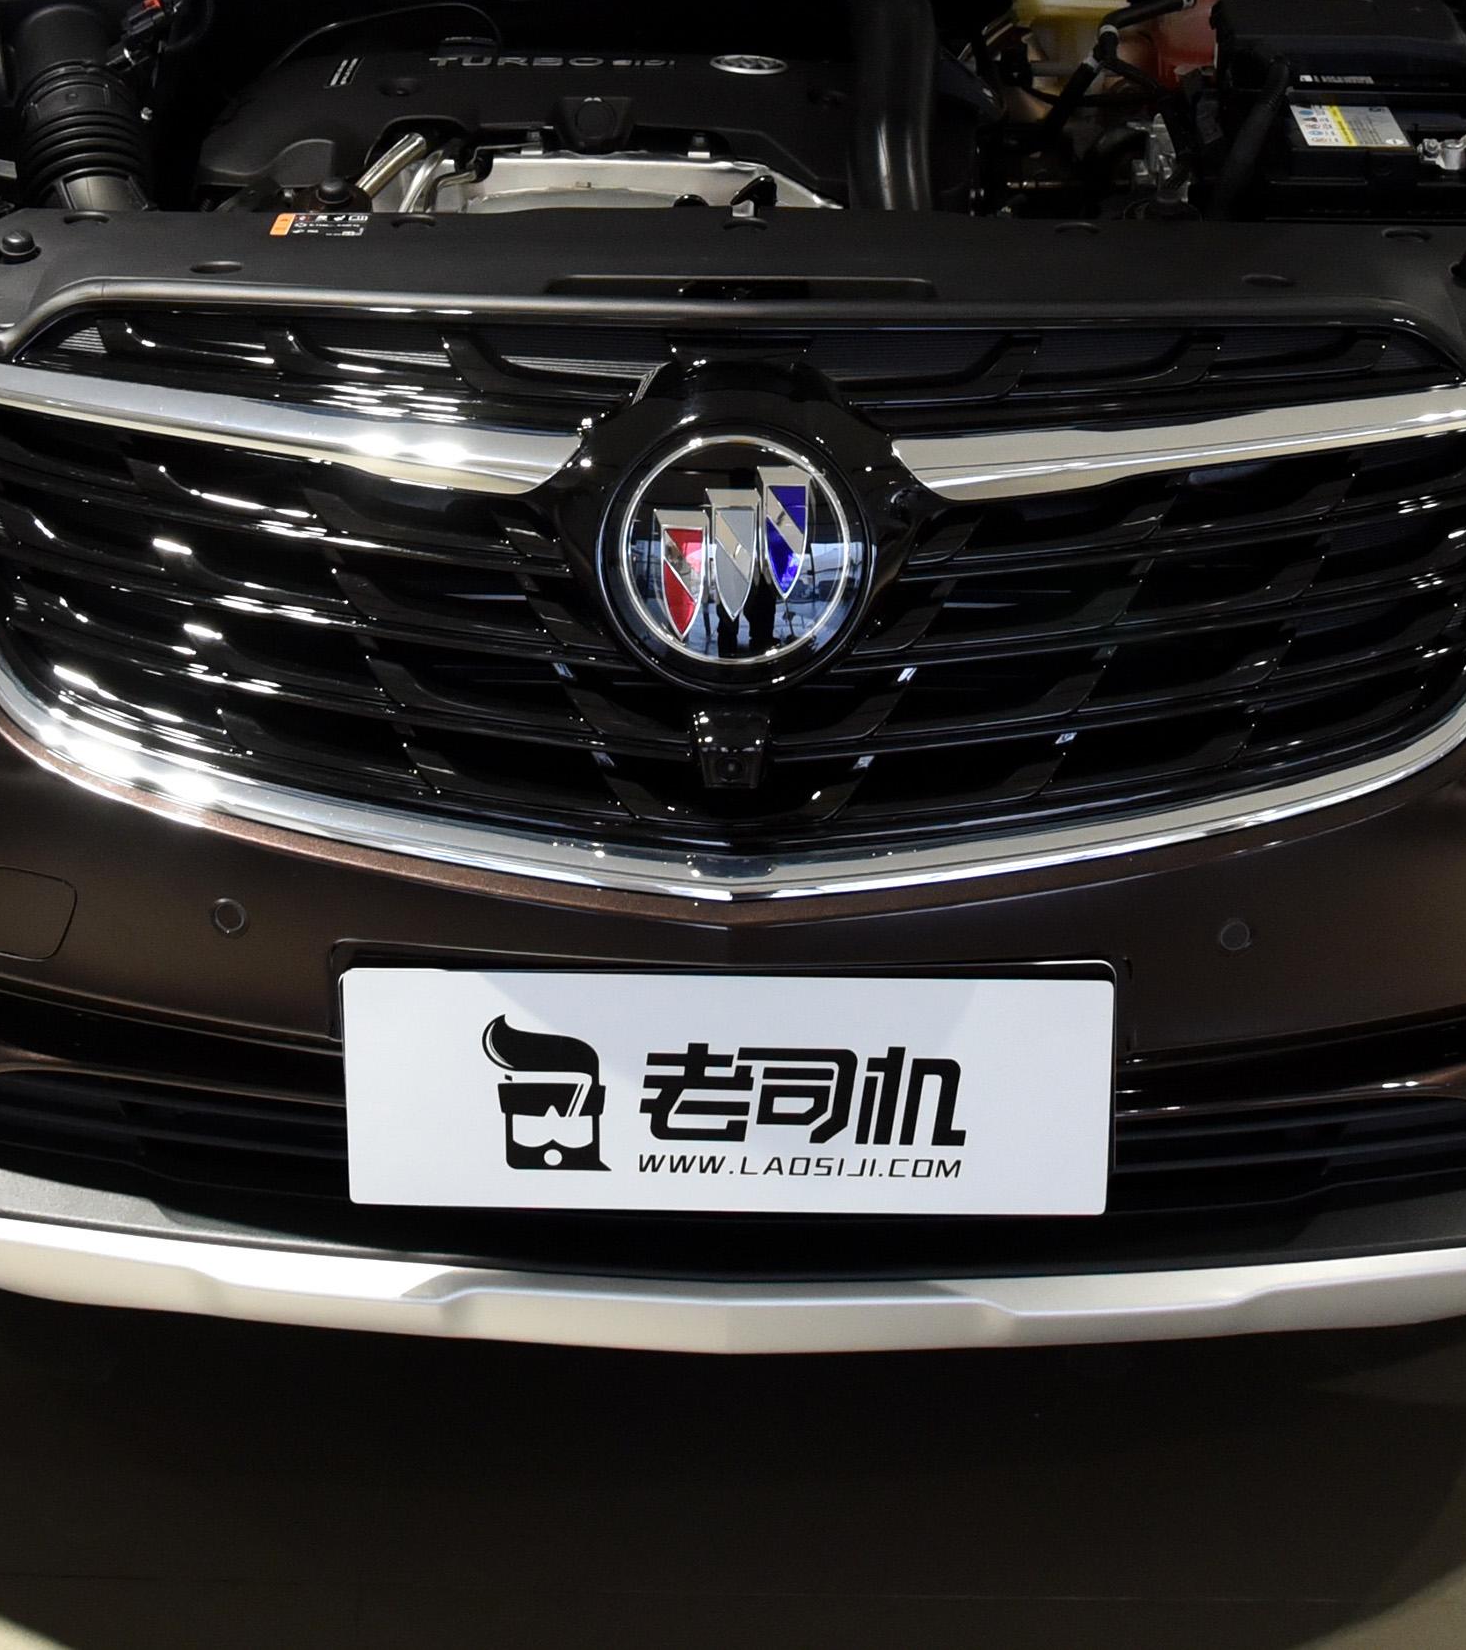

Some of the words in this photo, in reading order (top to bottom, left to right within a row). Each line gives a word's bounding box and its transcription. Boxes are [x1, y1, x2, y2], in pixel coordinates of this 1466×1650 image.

[428, 56, 605, 67] TURBO
[639, 1042, 967, 1147] 老司机
[638, 1154, 962, 1179] WWW.LAOSIJI.COM
